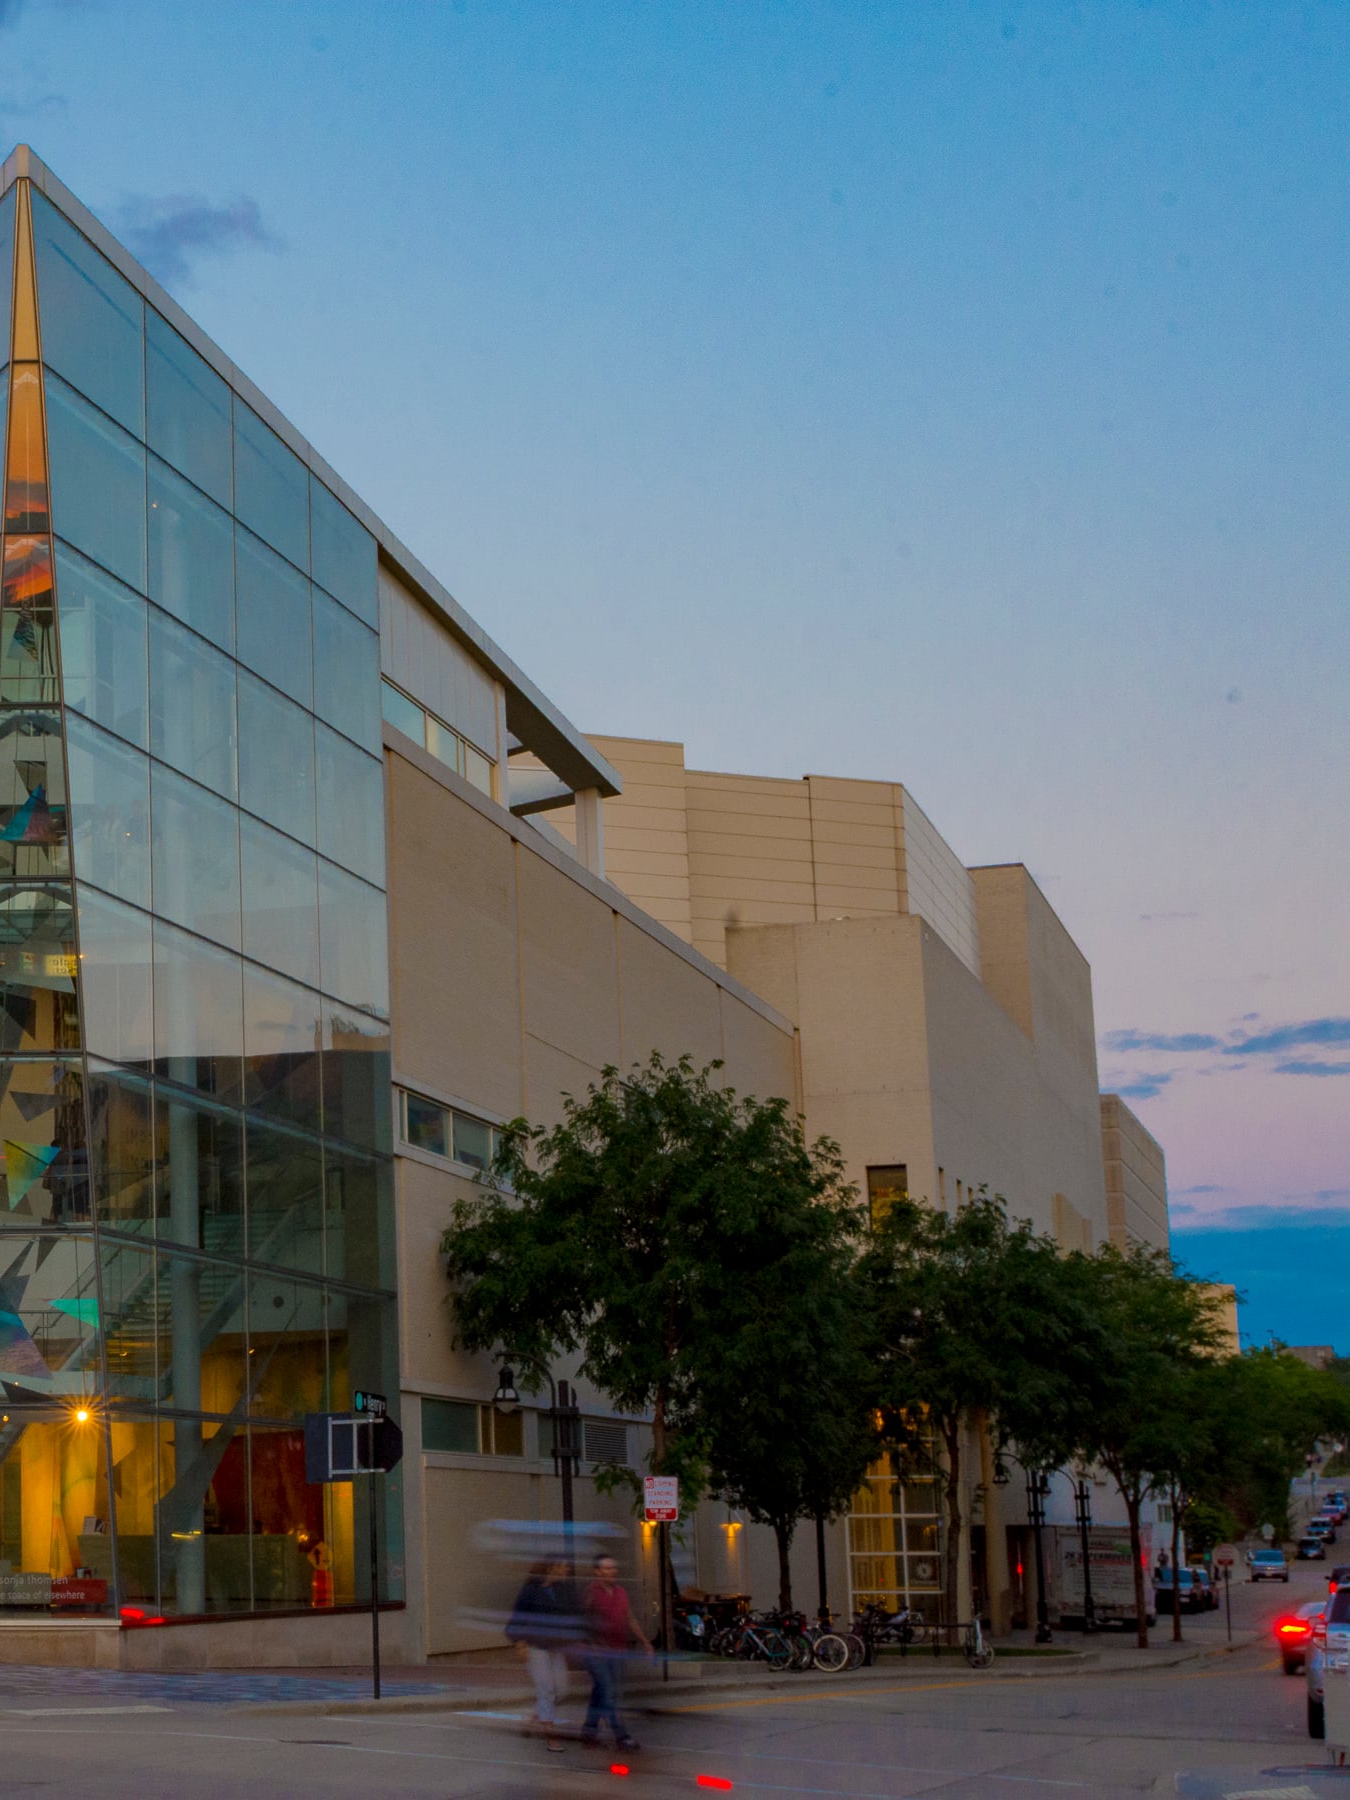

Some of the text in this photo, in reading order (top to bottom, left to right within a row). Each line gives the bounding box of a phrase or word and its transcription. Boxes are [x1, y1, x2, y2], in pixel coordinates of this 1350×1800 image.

[0, 1575, 68, 1587] sonja thomsen
[8, 1590, 31, 1602] space
[33, 1589, 42, 1600] of
[44, 1589, 85, 1600] elsewhere
